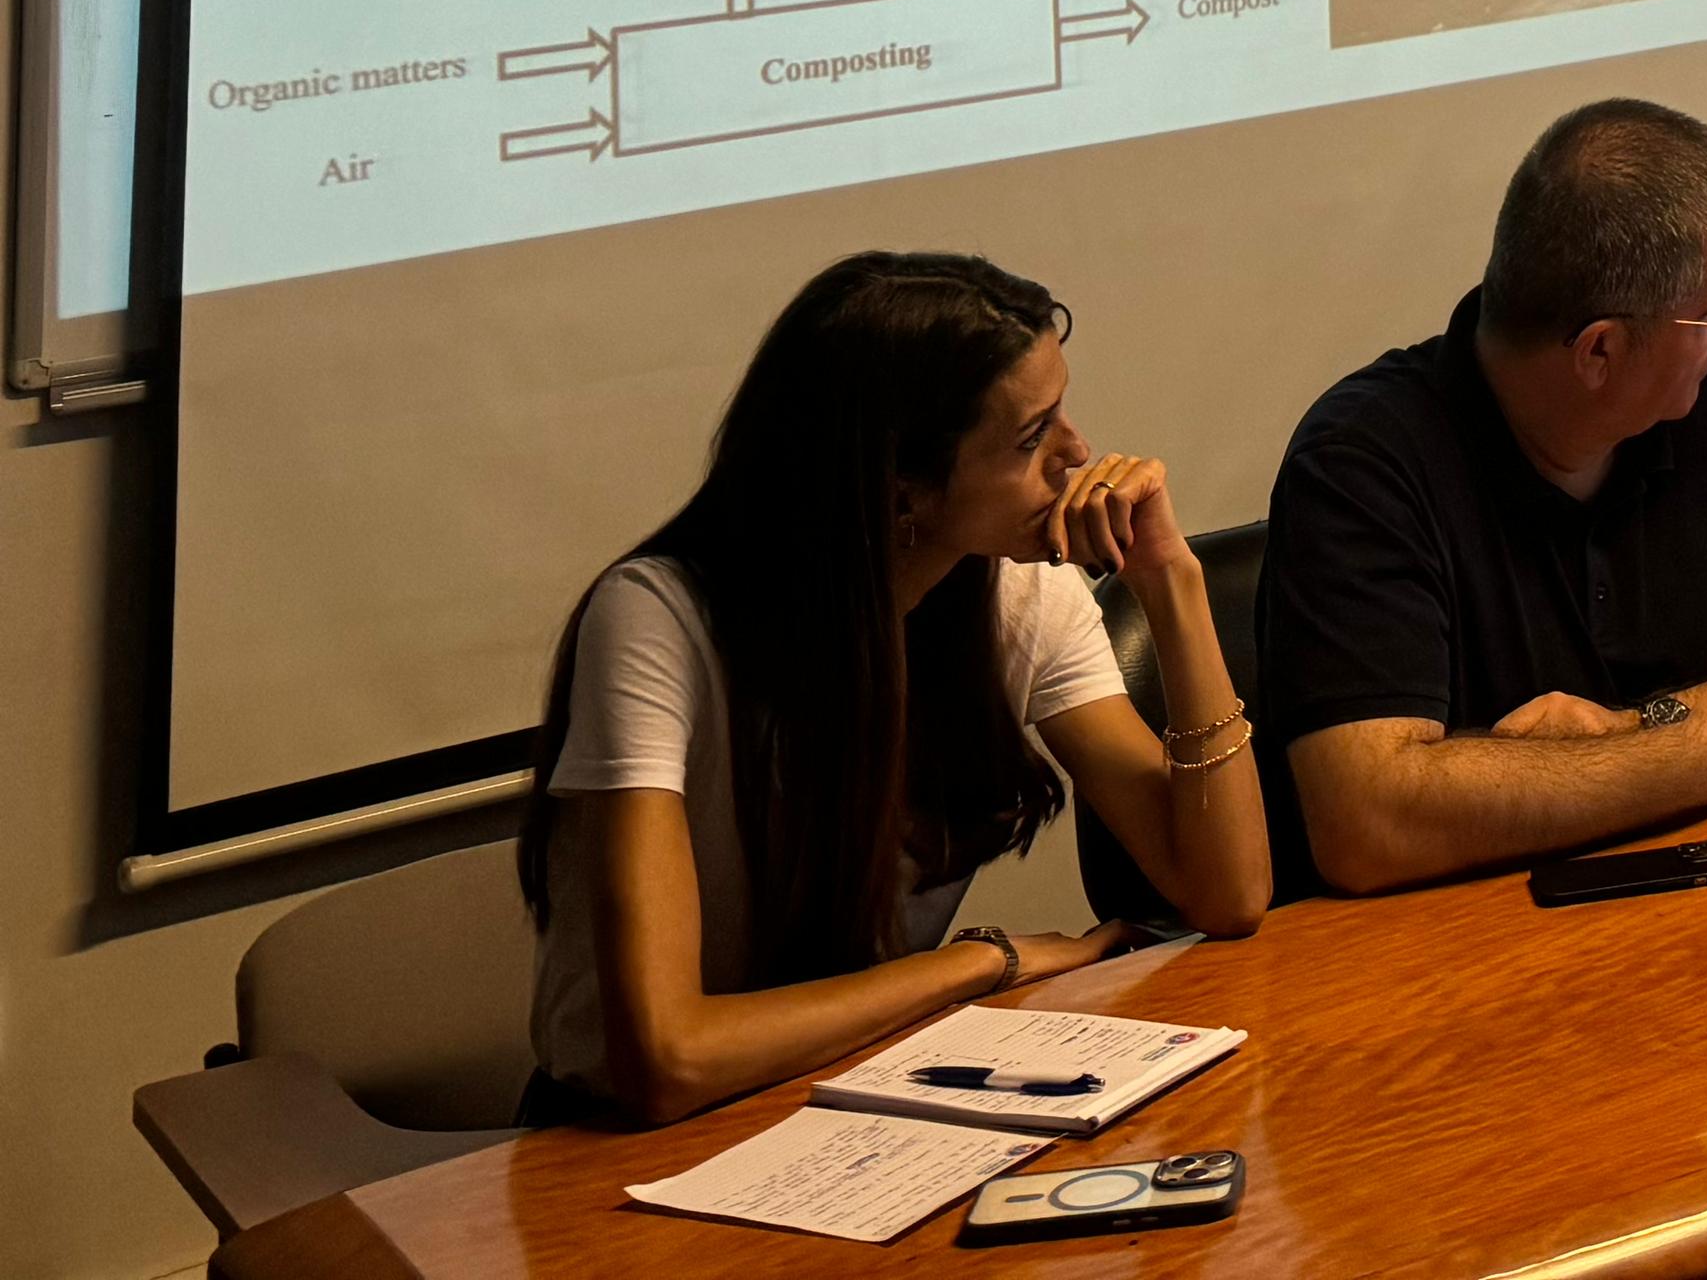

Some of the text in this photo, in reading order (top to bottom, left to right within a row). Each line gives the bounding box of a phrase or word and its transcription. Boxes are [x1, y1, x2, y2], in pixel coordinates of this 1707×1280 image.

[208, 57, 468, 113] Organic matters
[760, 42, 933, 86] Composting
[318, 152, 375, 187] Air
